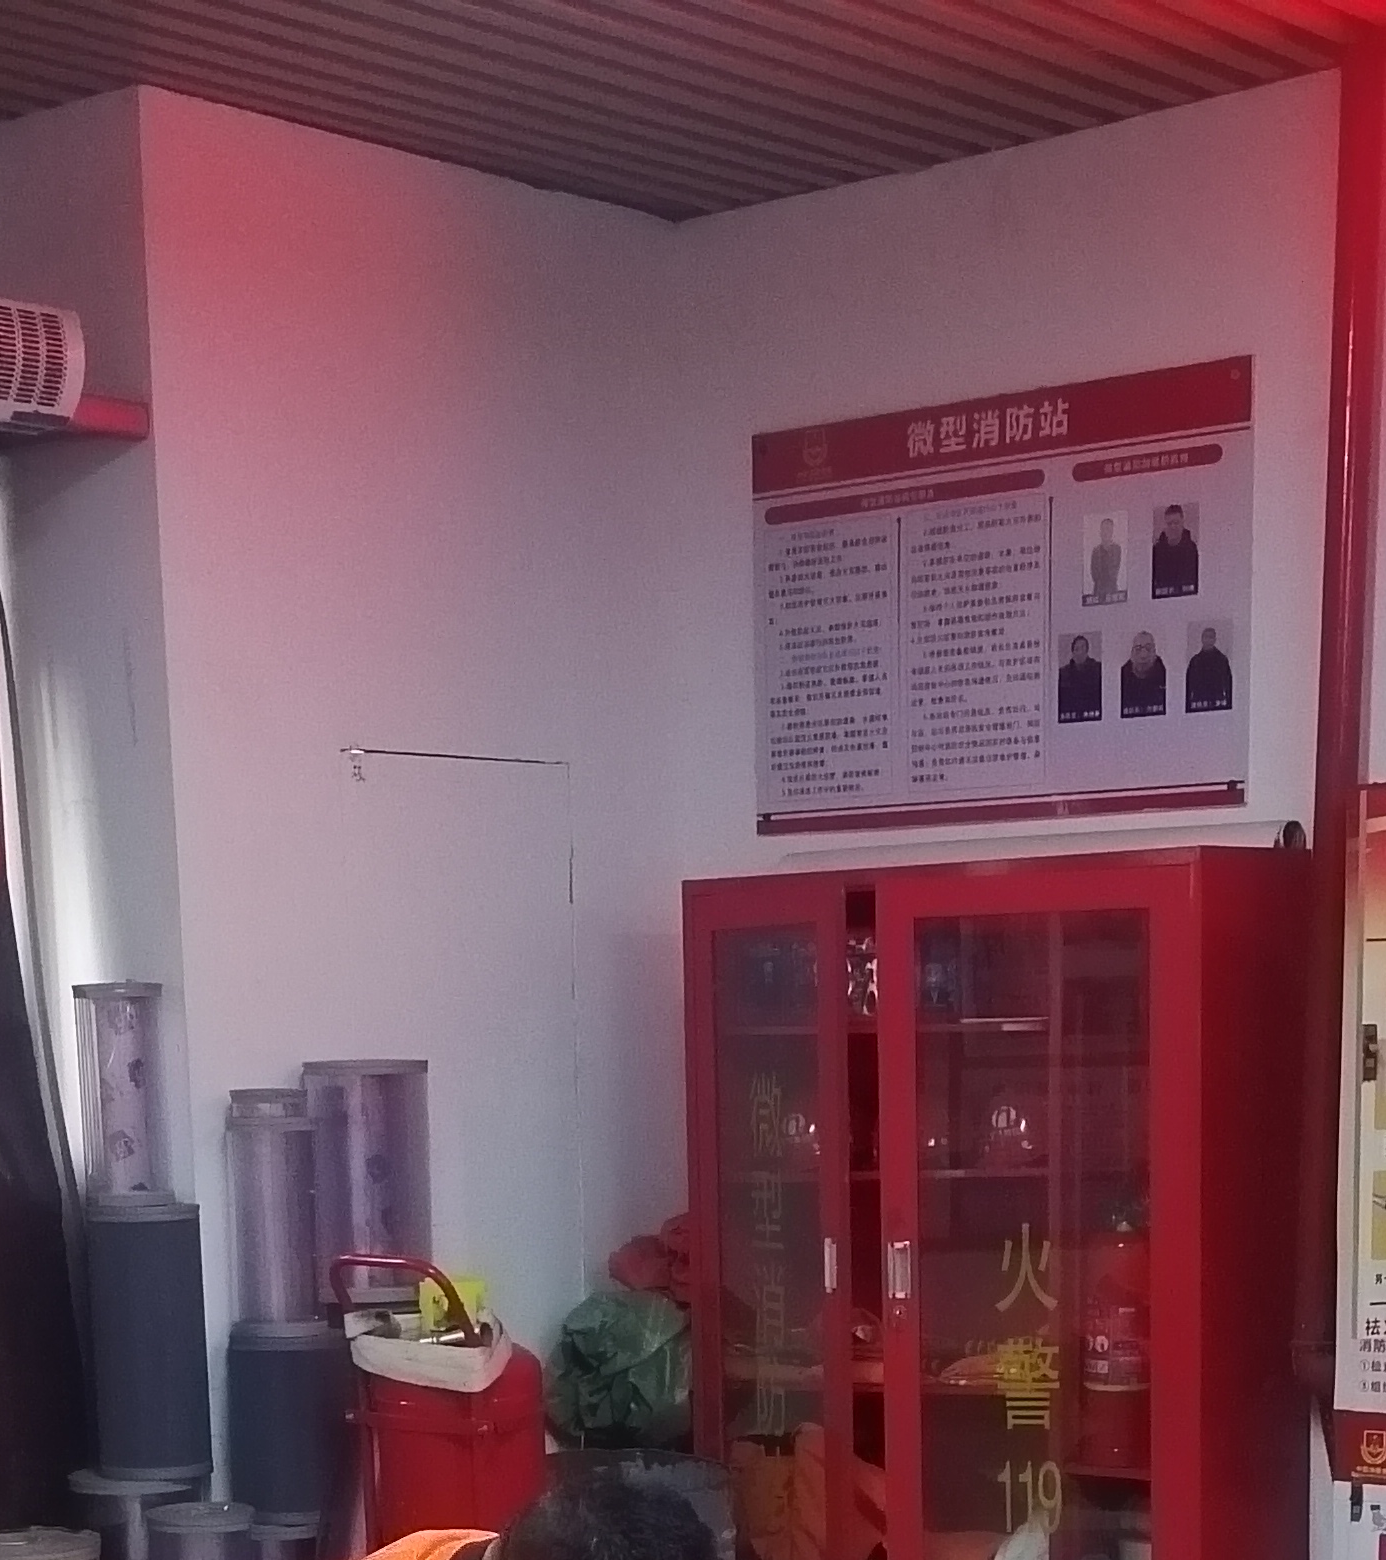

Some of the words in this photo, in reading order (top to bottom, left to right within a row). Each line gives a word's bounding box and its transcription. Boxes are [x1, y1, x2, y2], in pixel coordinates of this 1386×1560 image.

[907, 398, 1070, 458] 微型消防站
[994, 1222, 1060, 1431] 火警
[995, 1459, 1062, 1535] 119
